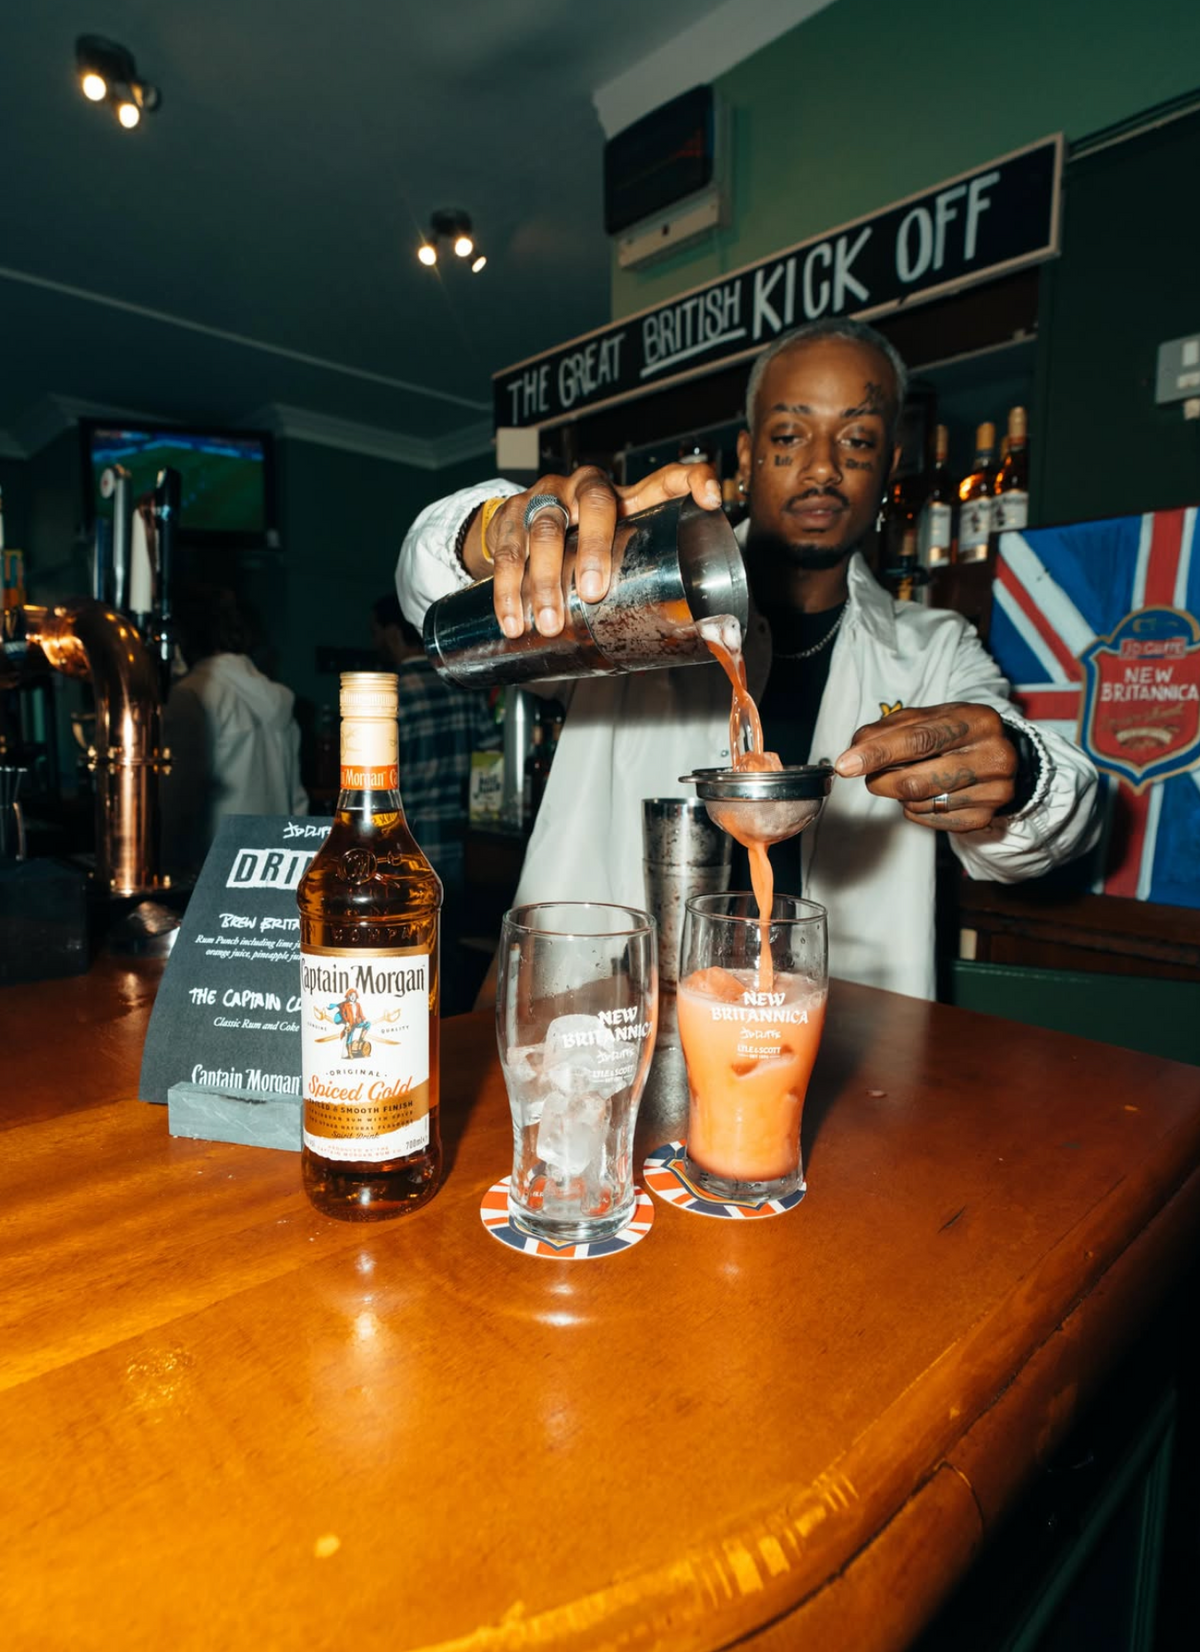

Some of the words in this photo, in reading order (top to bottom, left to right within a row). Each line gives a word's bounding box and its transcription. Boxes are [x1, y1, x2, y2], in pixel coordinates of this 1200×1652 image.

[507, 364, 550, 425] THE
[558, 332, 626, 408] GREAT
[642, 279, 743, 366] BRITISH
[753, 226, 873, 341] KICK
[896, 171, 1000, 283] OFF
[1124, 666, 1173, 684] NEW
[1100, 683, 1199, 702] BRITANNICA
[345, 769, 384, 788] Morgan
[219, 913, 257, 929] BREW
[195, 934, 214, 943] Rum
[215, 935, 240, 946] Punch
[240, 937, 275, 949] including
[276, 939, 293, 949] lime
[205, 949, 231, 959] orange
[251, 950, 289, 962] pineapple
[350, 965, 425, 997] Morgan
[189, 987, 217, 1005] THE
[223, 989, 281, 1011] CAPTAIN
[742, 991, 786, 1007] NEW
[598, 1006, 638, 1026] NEW
[711, 1006, 809, 1025] BRITANNICA
[213, 1017, 241, 1028] Classic
[241, 1019, 262, 1030] Rum
[262, 1021, 280, 1031] and
[280, 1022, 300, 1032] Coke
[381, 1025, 409, 1035] QUALITY
[759, 1046, 782, 1055] SCOTT
[329, 1068, 381, 1078] ORIGINAL
[308, 1075, 364, 1102] Spiced
[367, 1076, 413, 1103] Gold
[383, 1101, 413, 1113] FINISH
